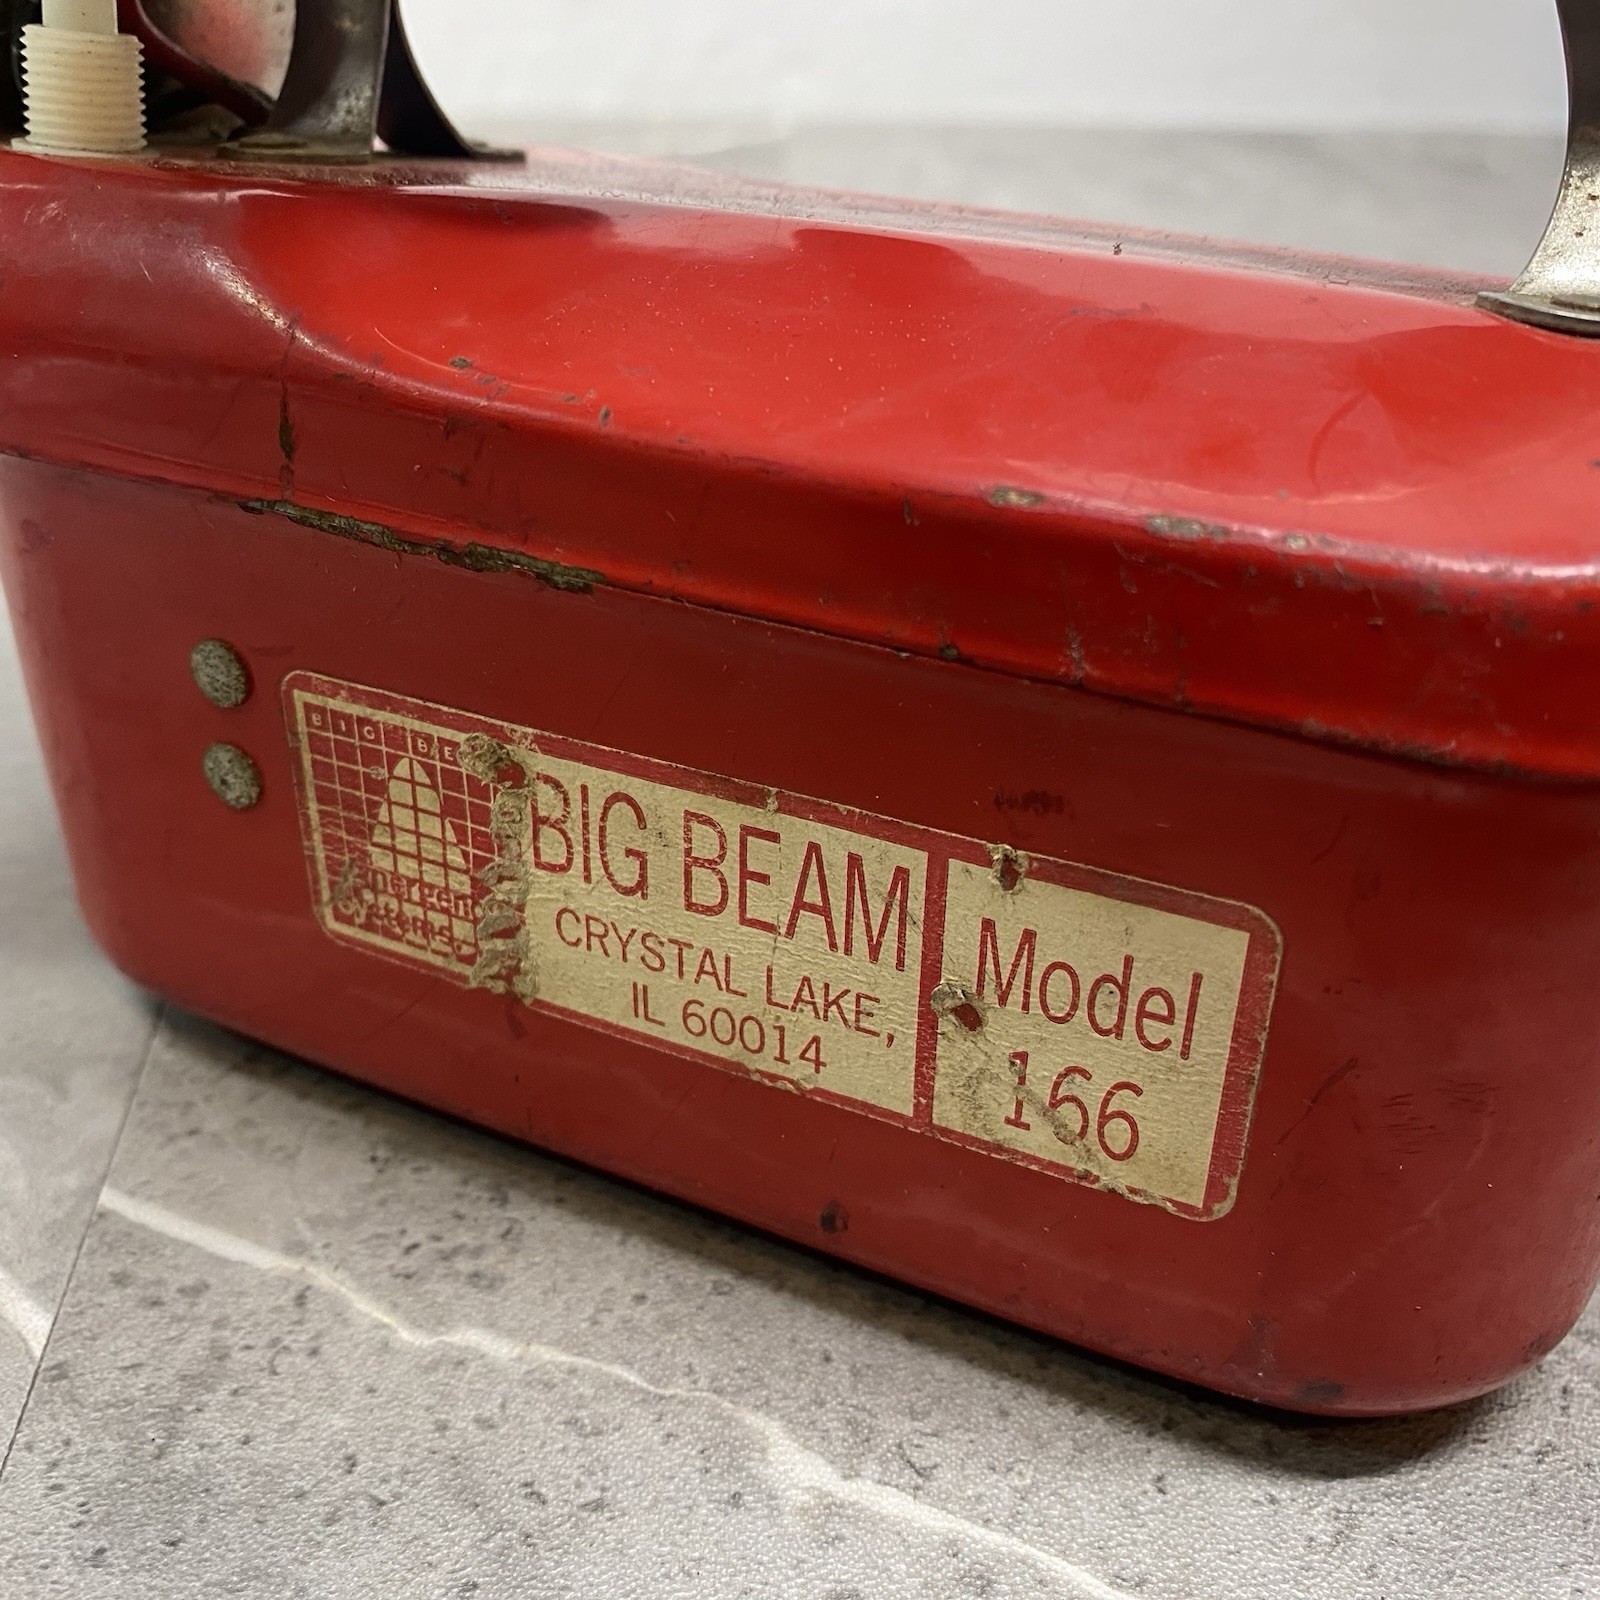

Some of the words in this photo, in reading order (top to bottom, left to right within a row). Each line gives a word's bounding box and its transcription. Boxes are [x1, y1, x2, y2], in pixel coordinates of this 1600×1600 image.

[311, 712, 376, 740] BIG
[531, 771, 649, 900] BIG
[683, 809, 911, 972] BEAM
[555, 907, 748, 998] CRYSTAL
[765, 965, 895, 1048] LAKE,
[632, 981, 666, 1027] IL
[681, 999, 828, 1075] 60014
[975, 916, 1204, 1061] Model
[1003, 1050, 1144, 1162] 166
